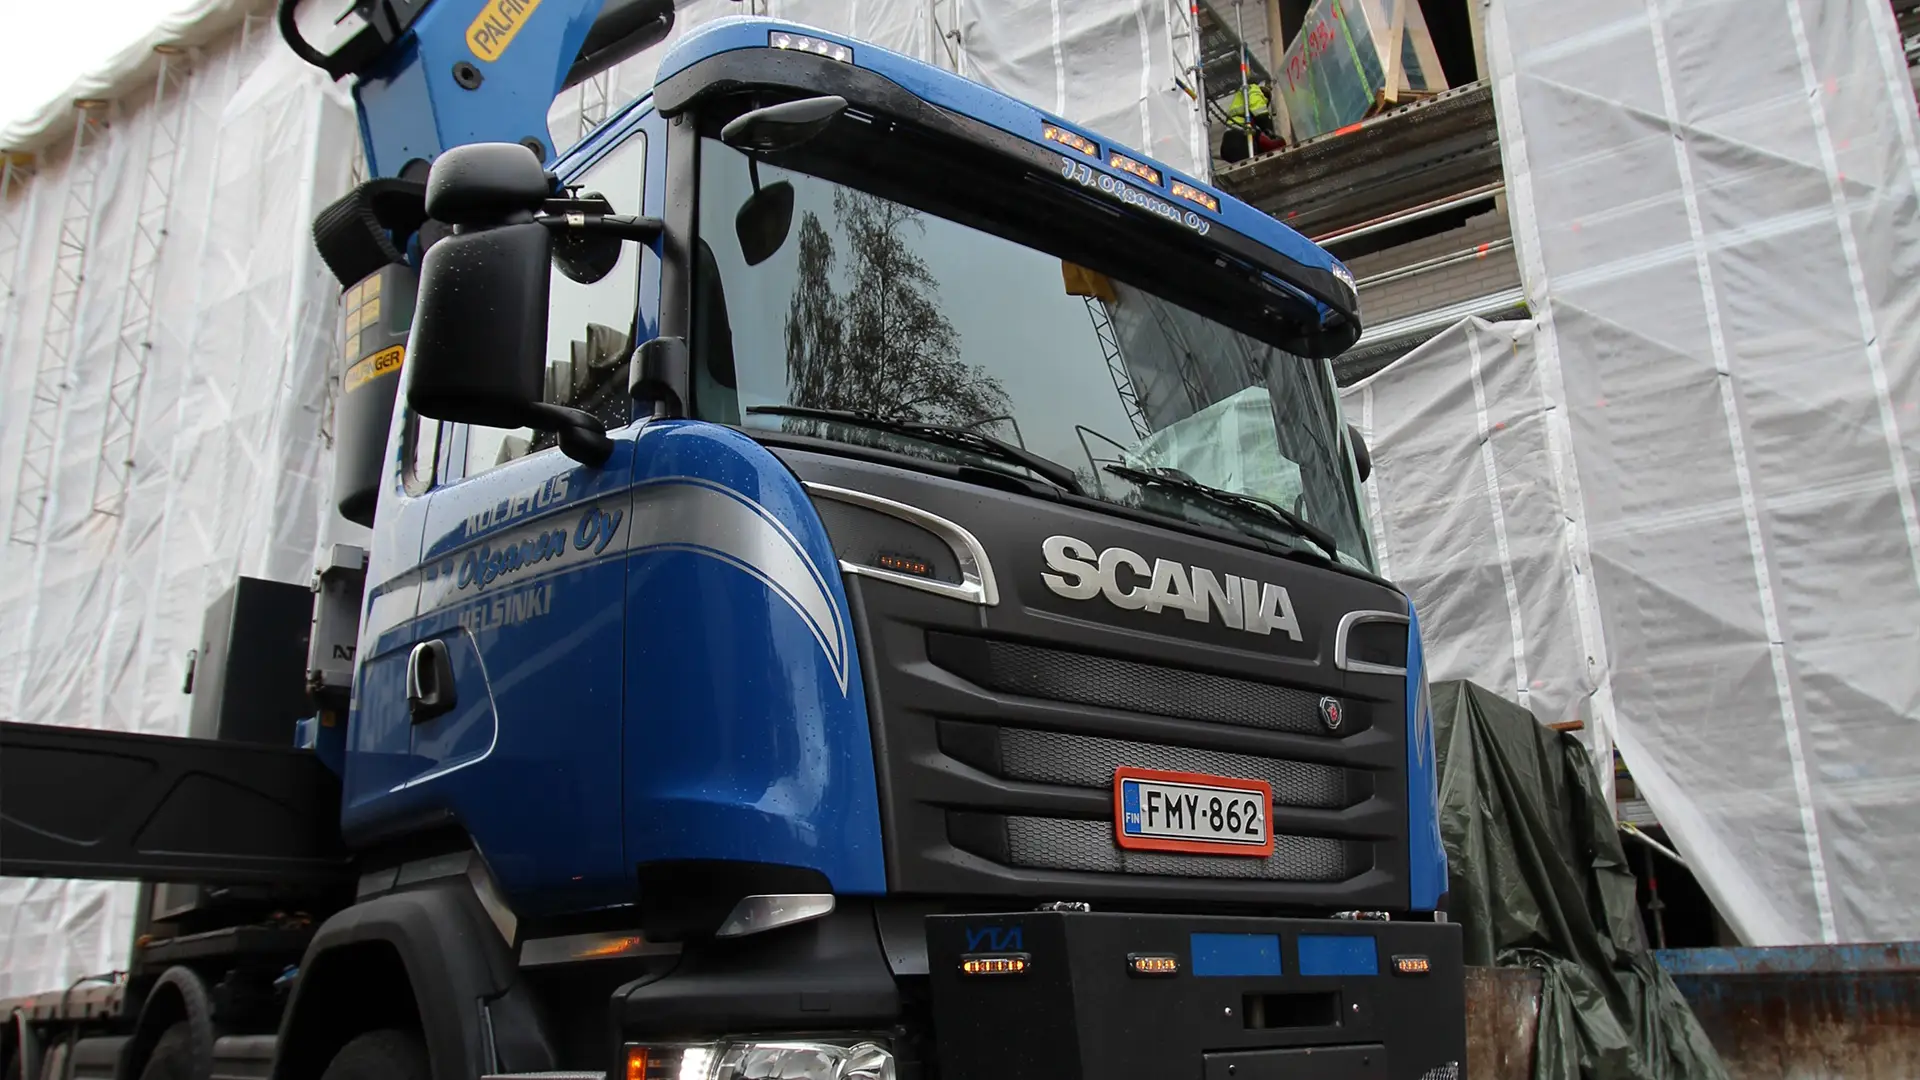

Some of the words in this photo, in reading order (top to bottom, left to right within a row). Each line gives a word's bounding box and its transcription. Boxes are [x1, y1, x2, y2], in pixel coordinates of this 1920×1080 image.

[1061, 157, 1096, 186] J.J.
[1097, 174, 1182, 223] Oksanen
[1184, 211, 1210, 236] Oy
[464, 472, 571, 537] KULJETUS
[457, 527, 567, 590] Oksanen
[573, 507, 624, 555] Oy
[458, 585, 553, 632] HELSINKI
[1040, 535, 1304, 642] SCANIA
[1125, 812, 1140, 824] FIN
[1147, 791, 1259, 835] FMY-862
